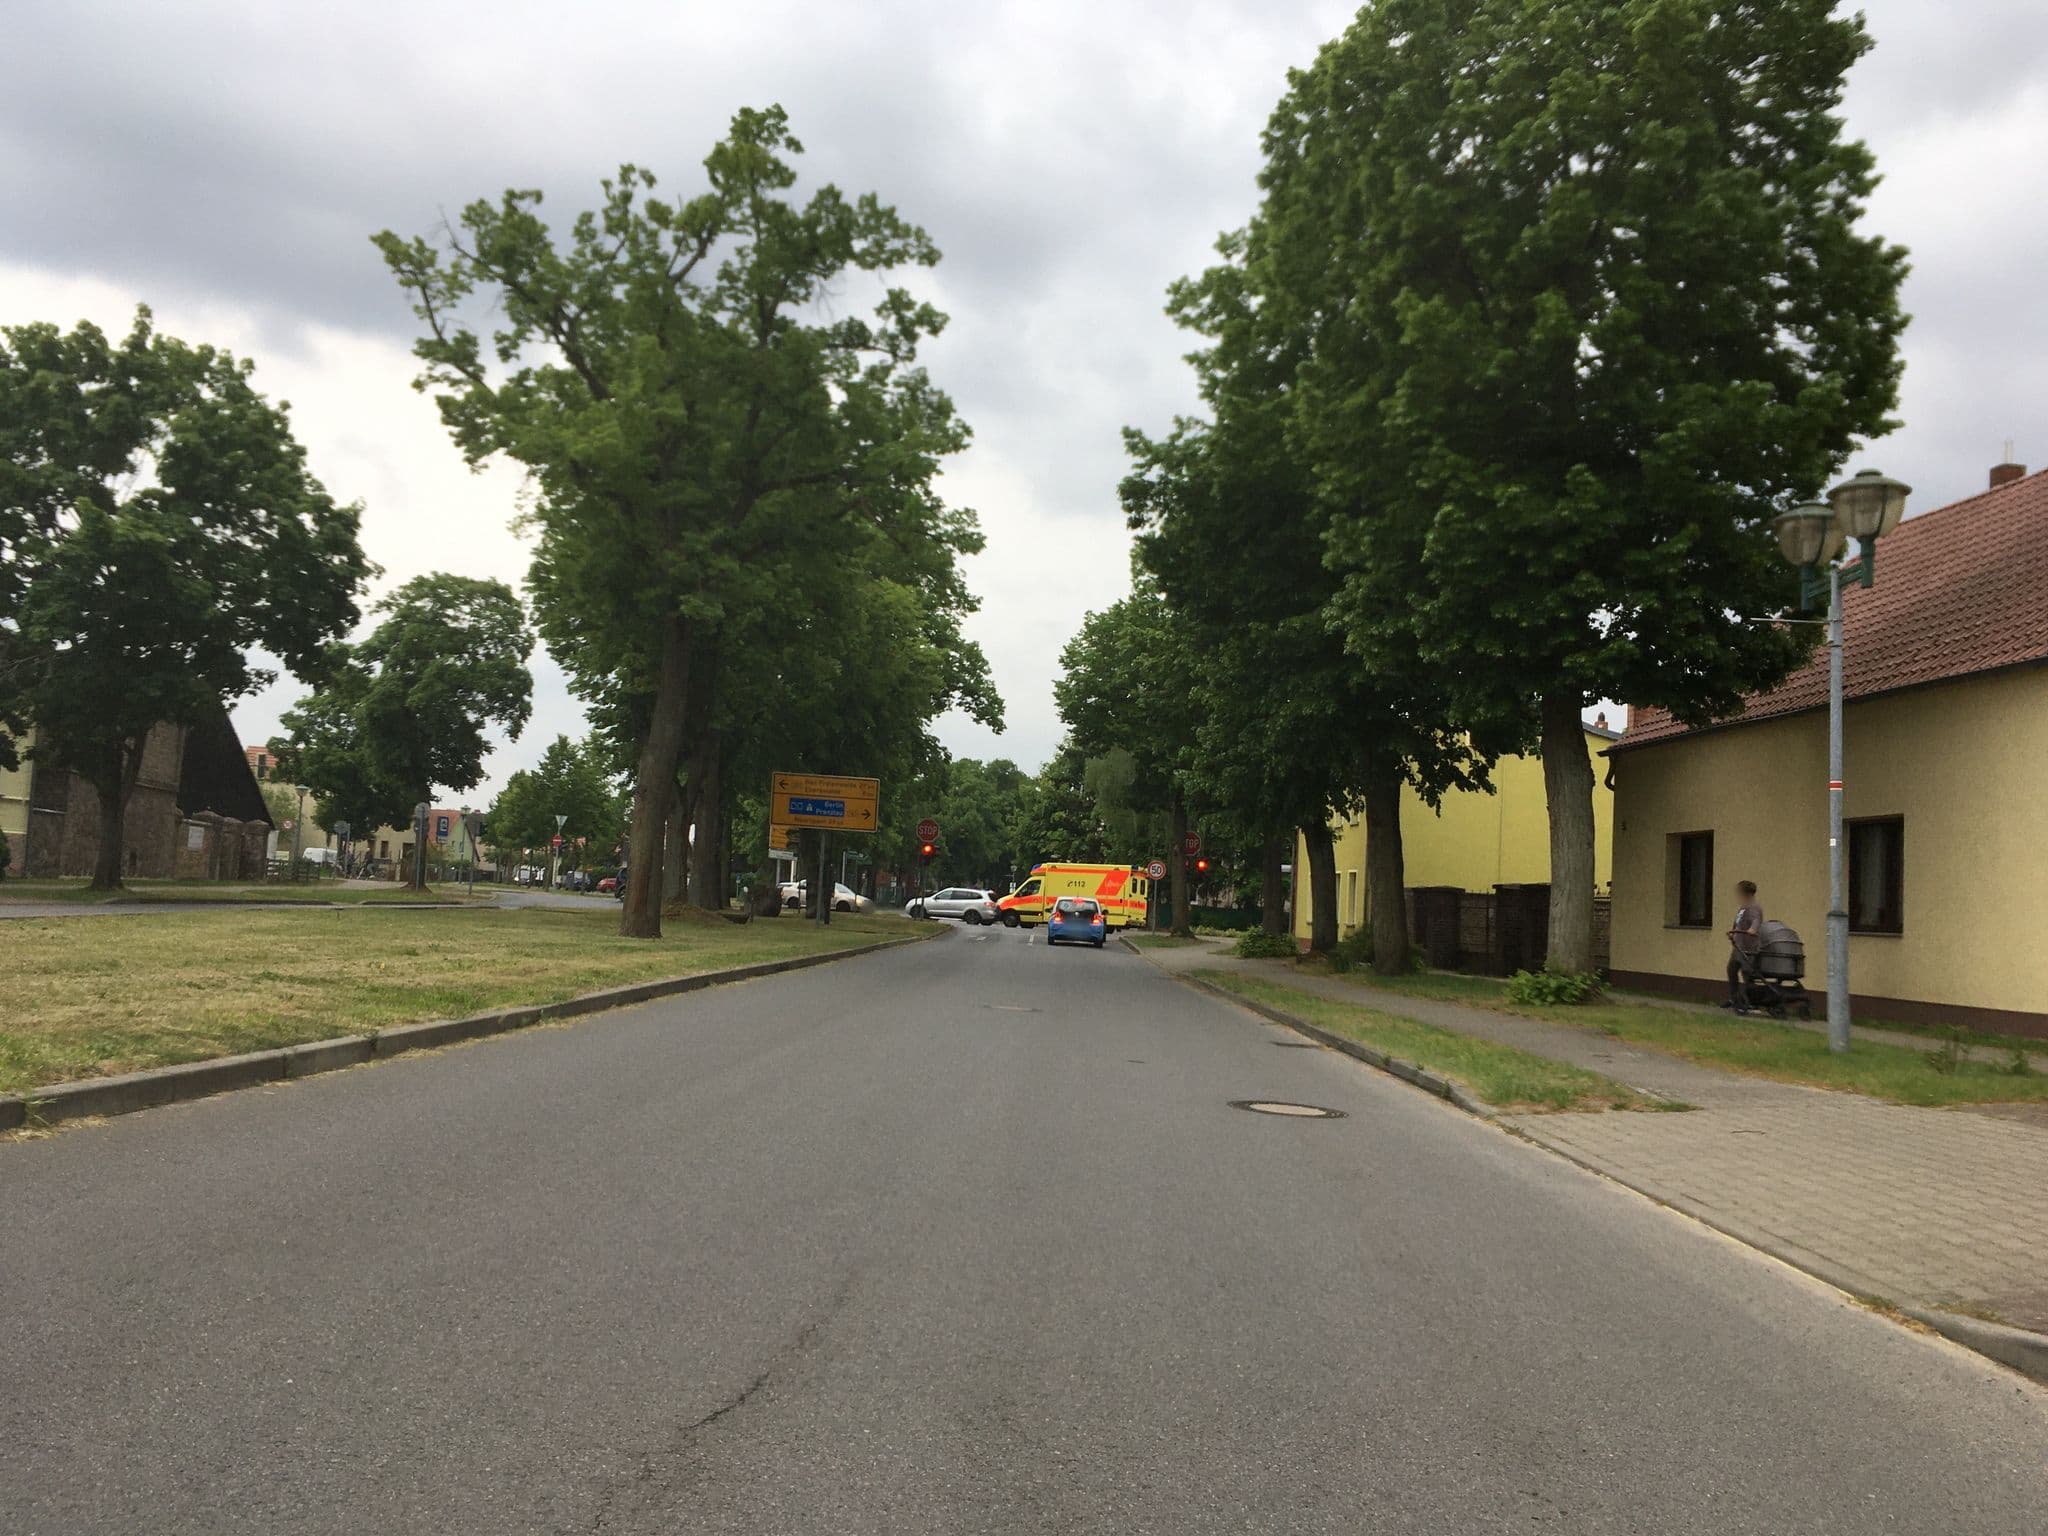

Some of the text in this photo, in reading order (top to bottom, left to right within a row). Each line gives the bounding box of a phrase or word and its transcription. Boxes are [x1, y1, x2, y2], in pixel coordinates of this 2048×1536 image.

[918, 825, 937, 835] STOP
[1185, 838, 1200, 849] TOP
[1151, 865, 1162, 875] 50
[1074, 880, 1086, 888] 112
